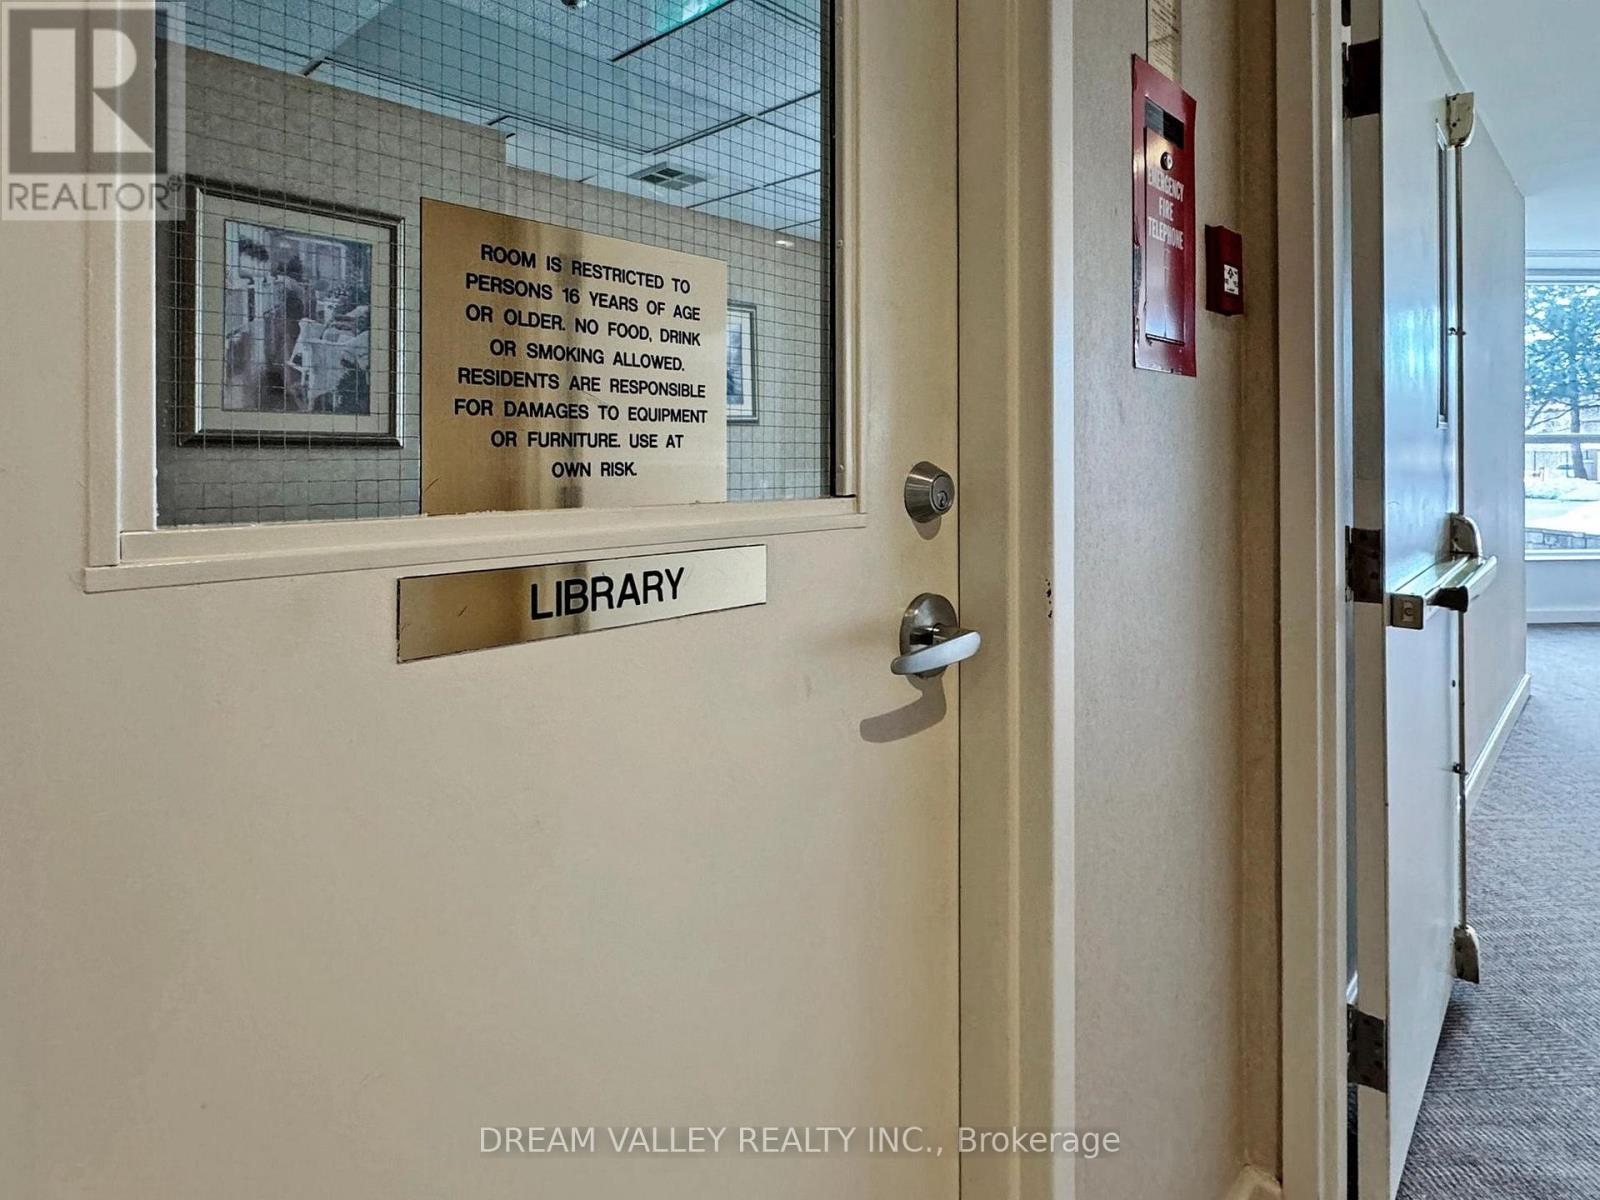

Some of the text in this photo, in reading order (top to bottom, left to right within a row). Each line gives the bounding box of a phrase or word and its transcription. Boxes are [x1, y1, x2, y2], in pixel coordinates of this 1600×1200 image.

[1159, 196, 1174, 221] FIRE
[1147, 216, 1184, 249] TELEPHONE
[480, 244, 690, 294] ROOM IS RESTRICTED TO
[465, 273, 700, 321] PERSONS 16 YEARS OF AGE
[465, 304, 701, 346] OR OLDER. NO FOOD, DRINK
[490, 339, 685, 371] OR SMOKING ALLOWED.
[458, 367, 705, 398] RESIDENTS ARE RESPONSIBLE
[454, 399, 708, 424] FOR DAMAGES TO EQUIPMENT
[491, 430, 684, 448] OR FURNITURE. USE AT
[552, 462, 637, 478] OWN RISK.
[530, 567, 685, 620] LIBRARY
